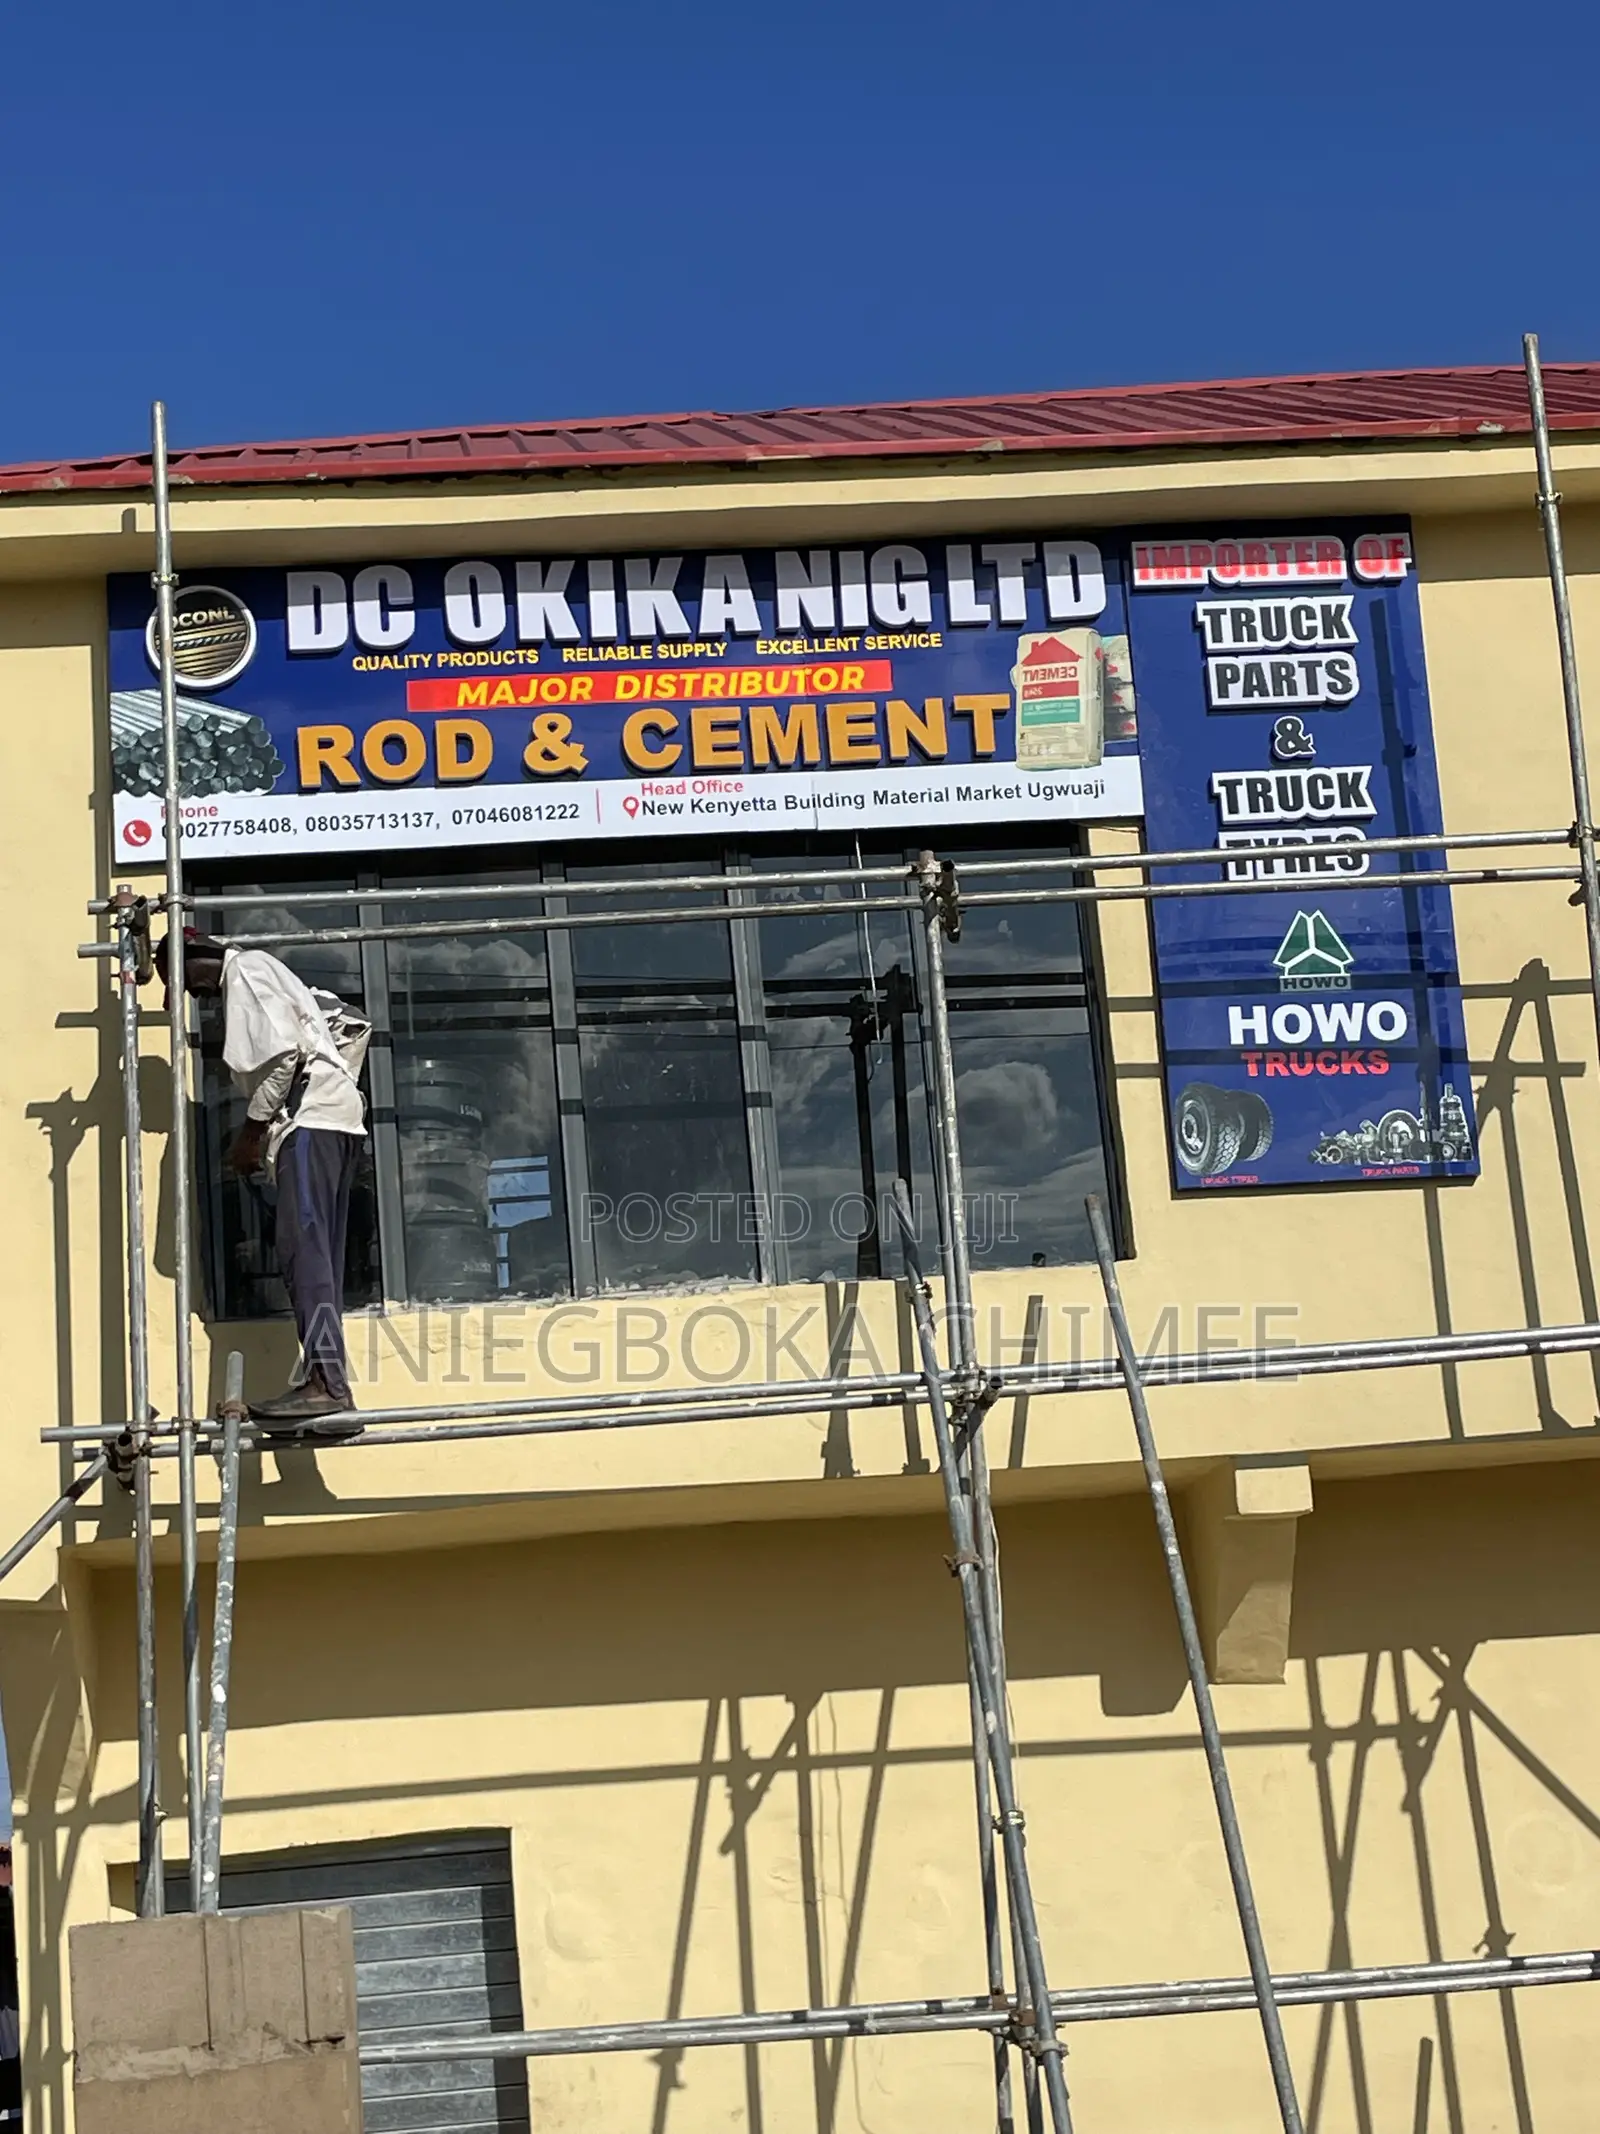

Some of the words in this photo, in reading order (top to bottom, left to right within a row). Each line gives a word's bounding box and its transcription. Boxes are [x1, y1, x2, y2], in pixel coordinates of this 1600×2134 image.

[1135, 539, 1345, 582] IMPORTER
[1354, 536, 1409, 576] OF
[286, 565, 416, 652] DC
[444, 555, 762, 646] OKIKA
[775, 544, 933, 630] NIG
[946, 540, 1107, 626] LTD
[1202, 603, 1351, 644] TRUCK
[353, 653, 432, 671] QUALITY
[437, 649, 539, 668] PRODUCTS
[562, 645, 653, 663] RELIABLE
[657, 642, 727, 660] SUPPLY
[756, 637, 861, 656] EXCELLENT
[865, 633, 943, 651] SERVICE
[457, 676, 594, 707] MAJOR
[614, 664, 867, 699] DISTRIBUTOR
[1214, 658, 1354, 699] PARTS
[297, 718, 494, 789] ROD
[523, 713, 589, 775] &
[622, 694, 1011, 770] CEMENT
[1274, 717, 1316, 758] &
[641, 780, 687, 796] Head
[692, 779, 744, 795] Office
[642, 799, 684, 817] New
[690, 796, 778, 817] Kenyetta
[784, 791, 866, 814] Building
[873, 786, 950, 806] Material
[956, 784, 1022, 803] Market
[1028, 779, 1106, 803] Ugwuaji
[1217, 771, 1369, 815] TRUCK
[305, 811, 441, 833] 08035713137,
[452, 803, 580, 826] 07046081222
[1283, 976, 1348, 989] HOWO
[1228, 1000, 1407, 1045] HOWO
[1240, 1049, 1390, 1077] TRUCKS
